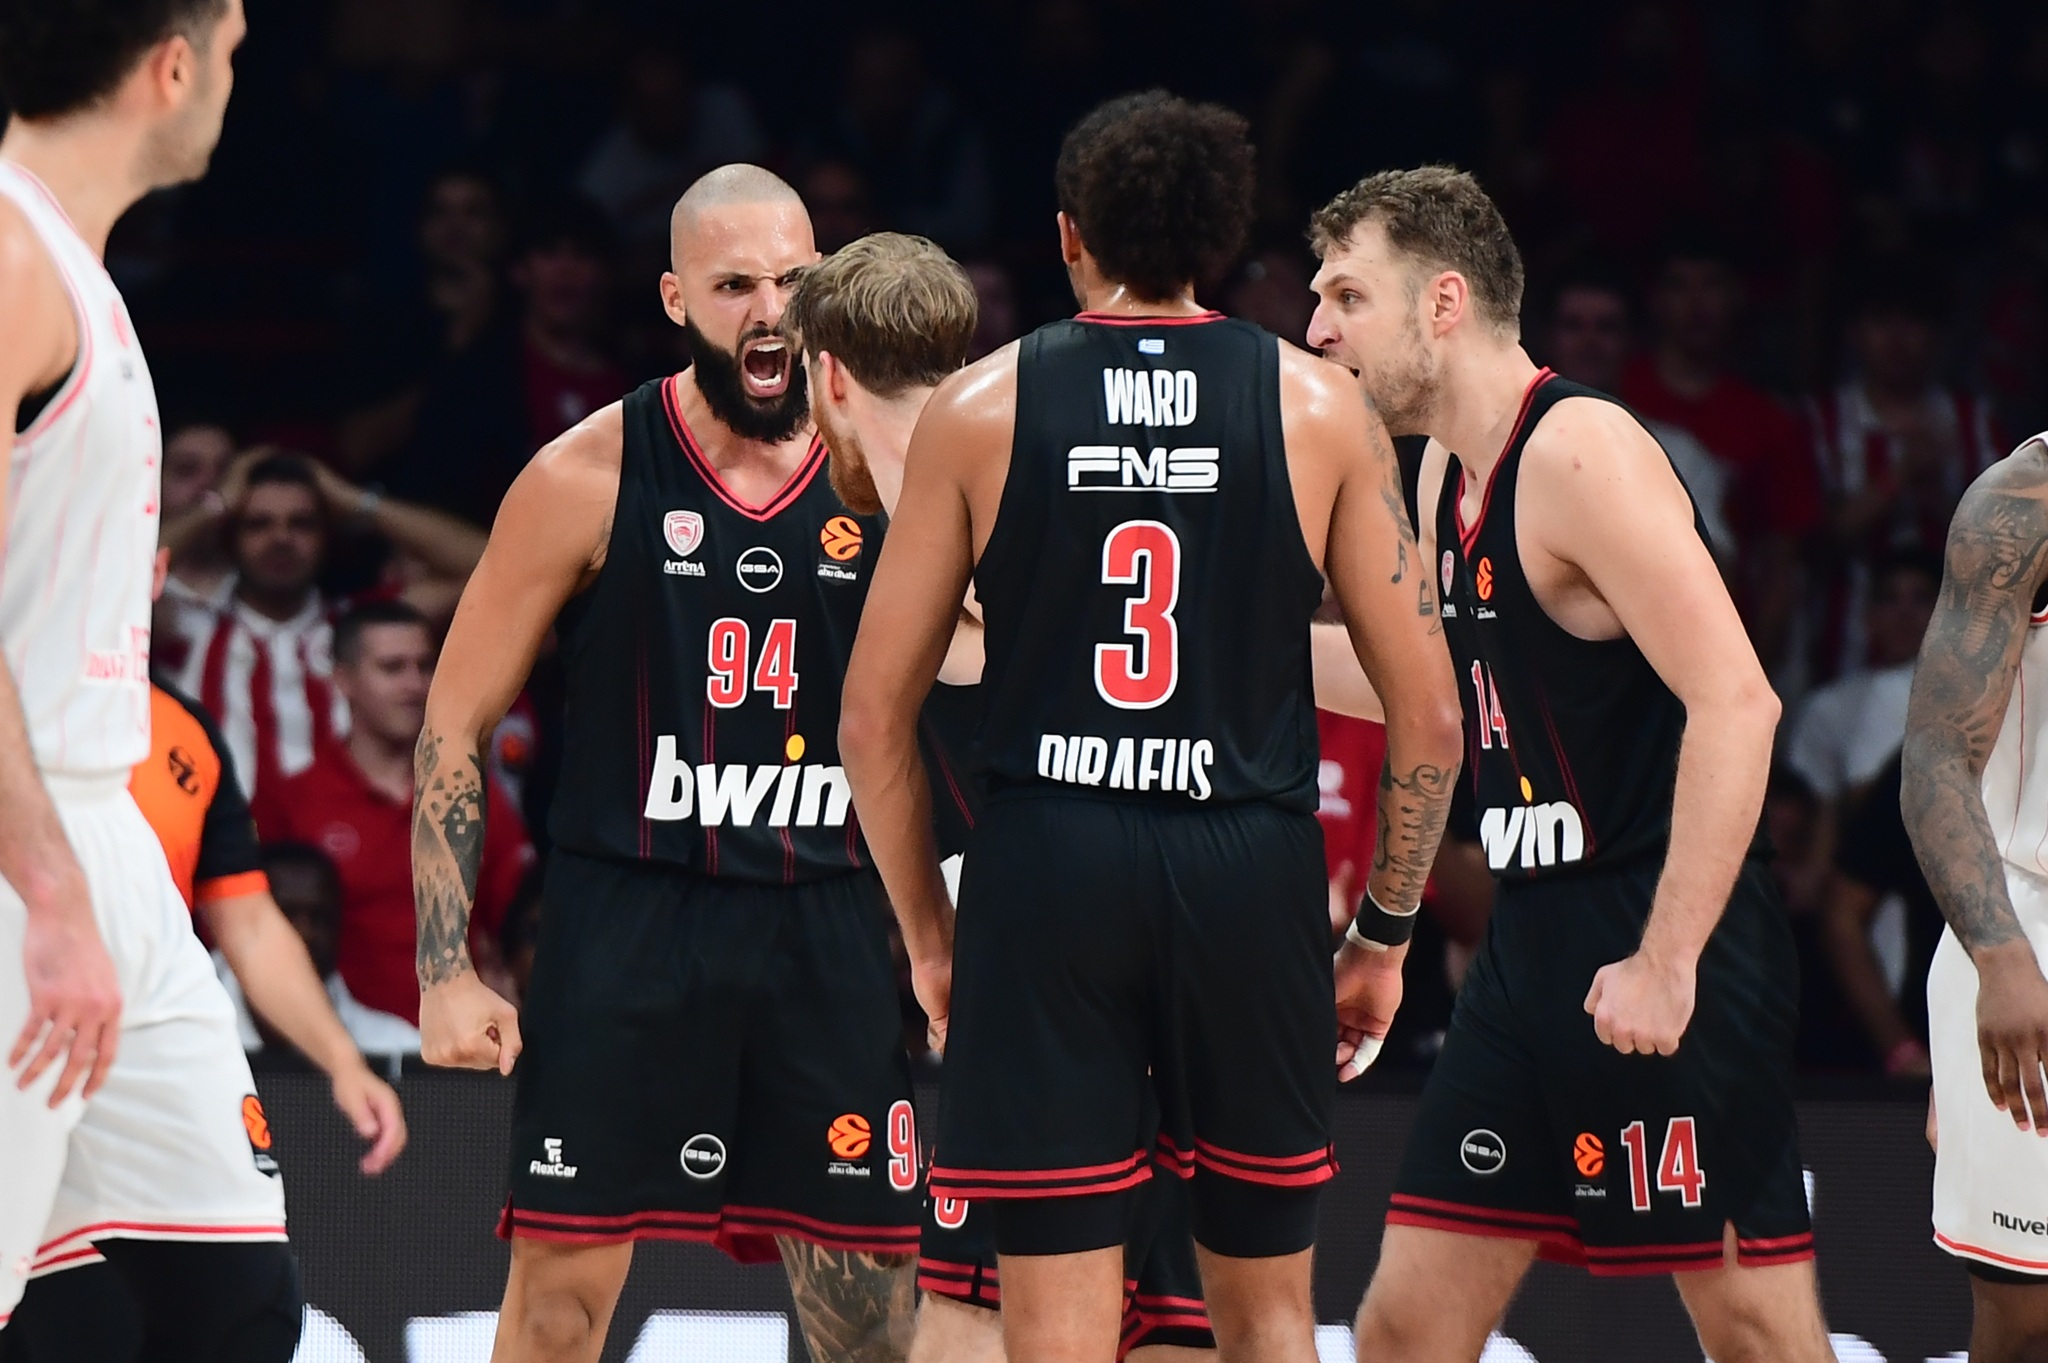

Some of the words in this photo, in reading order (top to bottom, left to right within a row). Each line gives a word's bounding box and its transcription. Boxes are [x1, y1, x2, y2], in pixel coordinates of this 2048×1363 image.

[1102, 367, 1198, 428] WARD
[1067, 445, 1221, 488] FMS
[1093, 518, 1182, 711] 3
[707, 617, 798, 710] 94
[1470, 659, 1510, 750] 14
[644, 734, 852, 827] bwin
[1479, 775, 1586, 871] win
[529, 1159, 578, 1178] FlexCar
[888, 1099, 922, 1191] 9
[1620, 1116, 1706, 1212] 14
